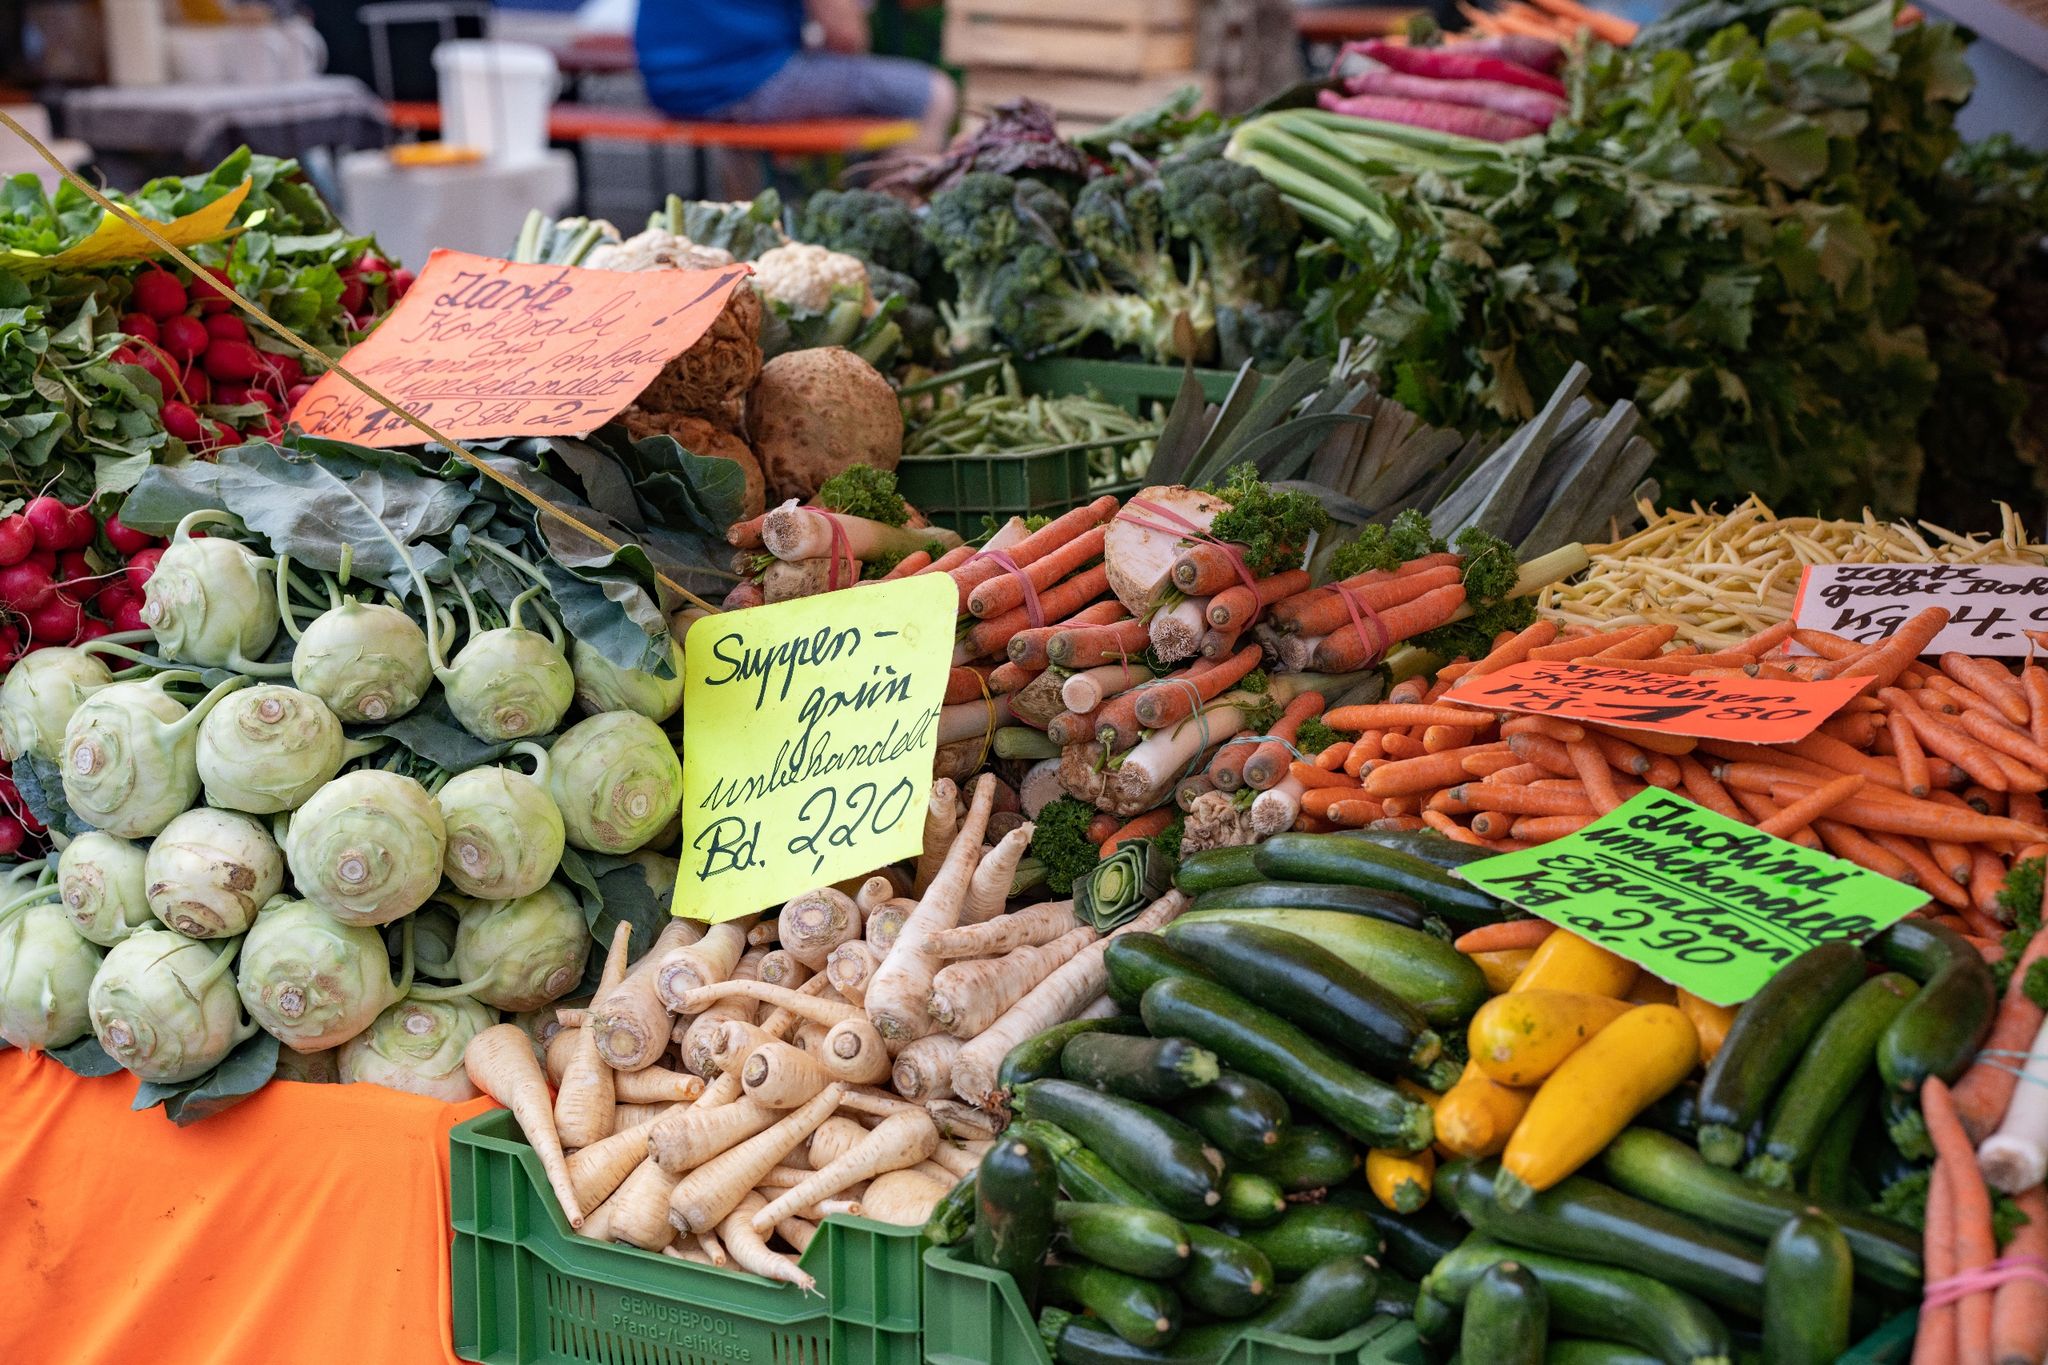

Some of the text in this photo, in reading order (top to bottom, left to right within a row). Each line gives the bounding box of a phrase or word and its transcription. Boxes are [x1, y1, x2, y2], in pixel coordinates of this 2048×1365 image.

[401, 290, 641, 343] Kohlrabi
[355, 334, 669, 388] eigenem Anbau
[468, 338, 546, 358] aus
[391, 366, 635, 396] unbehandelt
[1820, 580, 1948, 609] gelbe
[789, 665, 912, 771] grün
[699, 701, 941, 811] unbehandelt
[693, 776, 914, 882] Bd. 2,20
[1537, 853, 1793, 964] Eigenbau
[611, 1312, 752, 1363] Pfand-/Leihkiste
[619, 1295, 739, 1339] GEMÜSEPOOL
